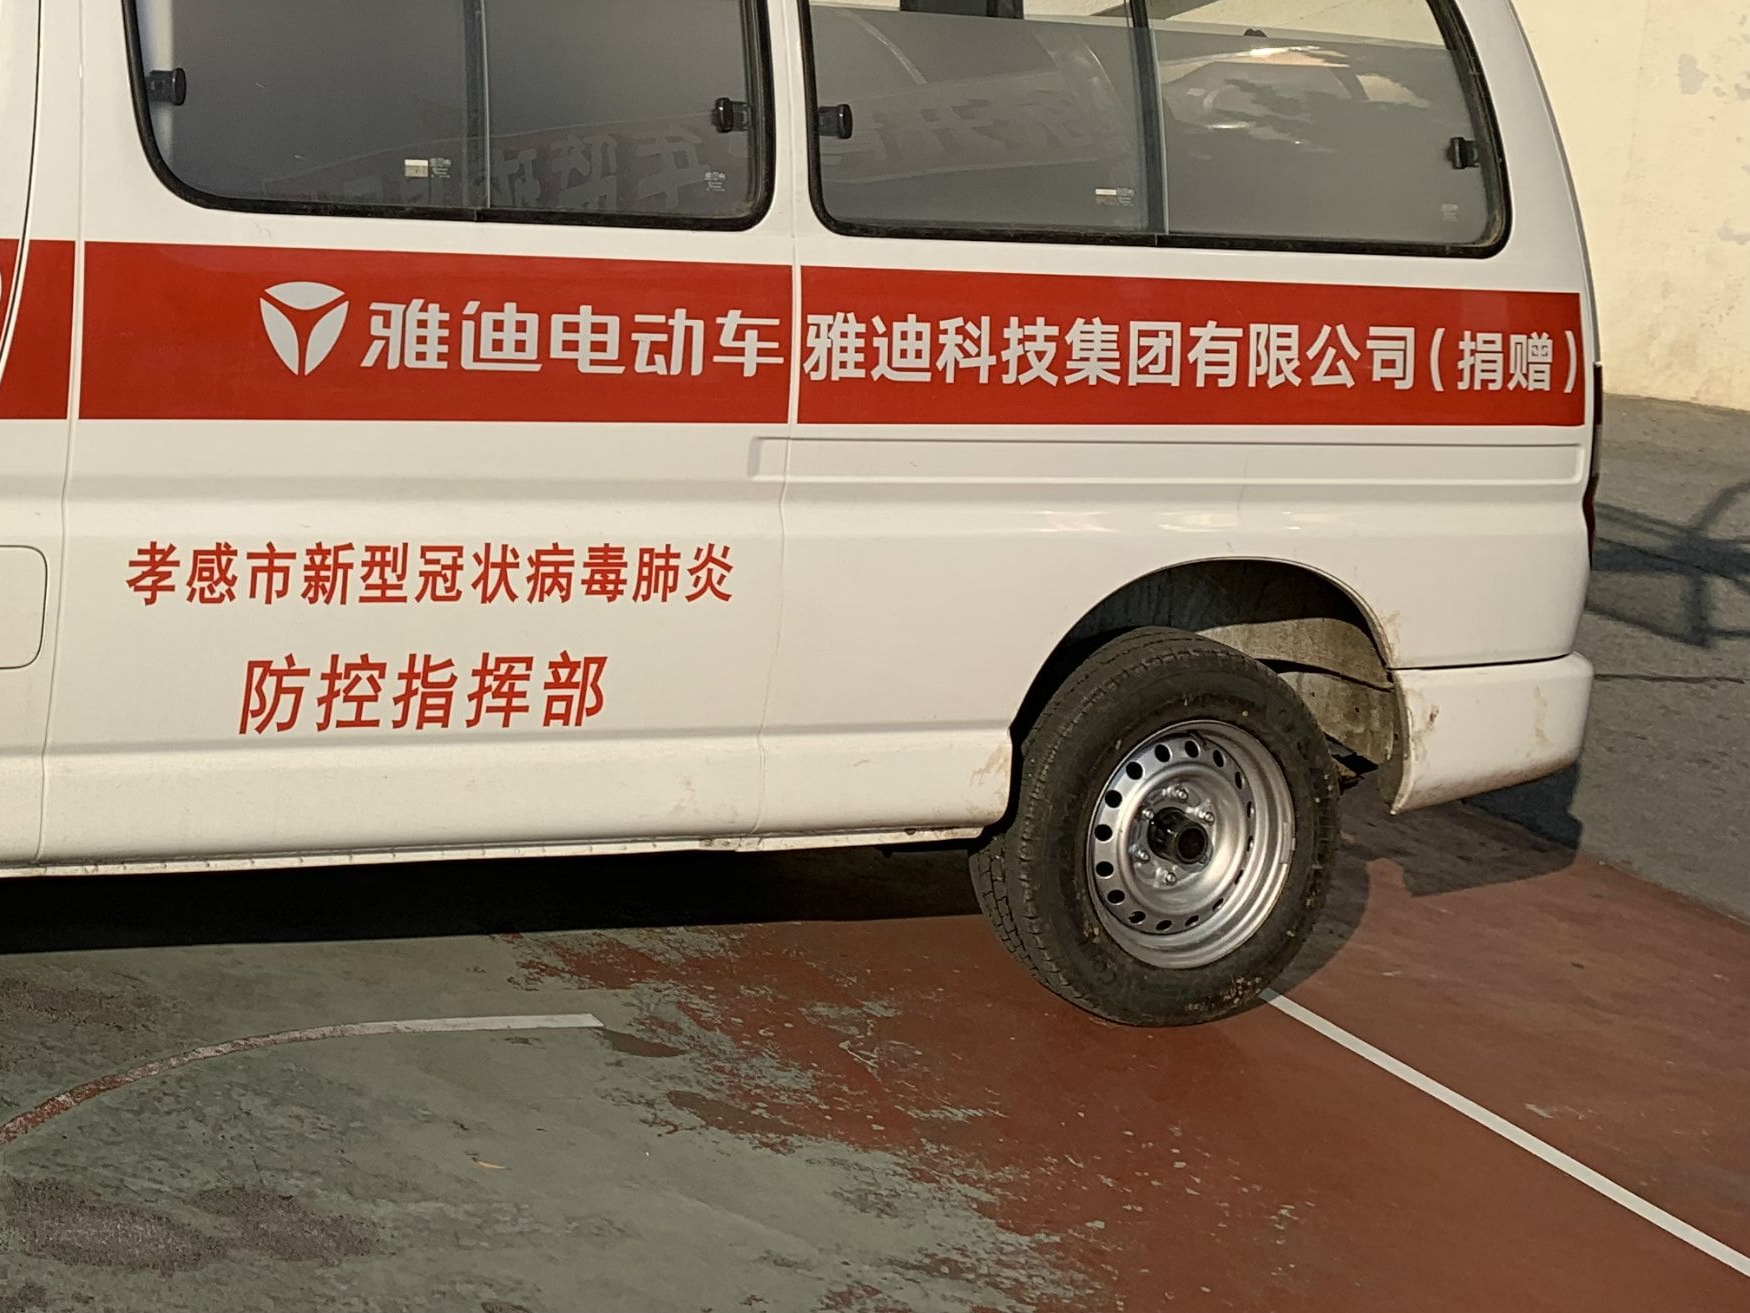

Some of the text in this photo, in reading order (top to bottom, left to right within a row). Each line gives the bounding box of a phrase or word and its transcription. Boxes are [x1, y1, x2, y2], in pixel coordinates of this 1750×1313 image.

[360, 299, 786, 378] 雅迪电动车
[126, 540, 735, 607] 孝感市新型冠状病毒肺炎
[238, 650, 609, 735] 防控指挥部
